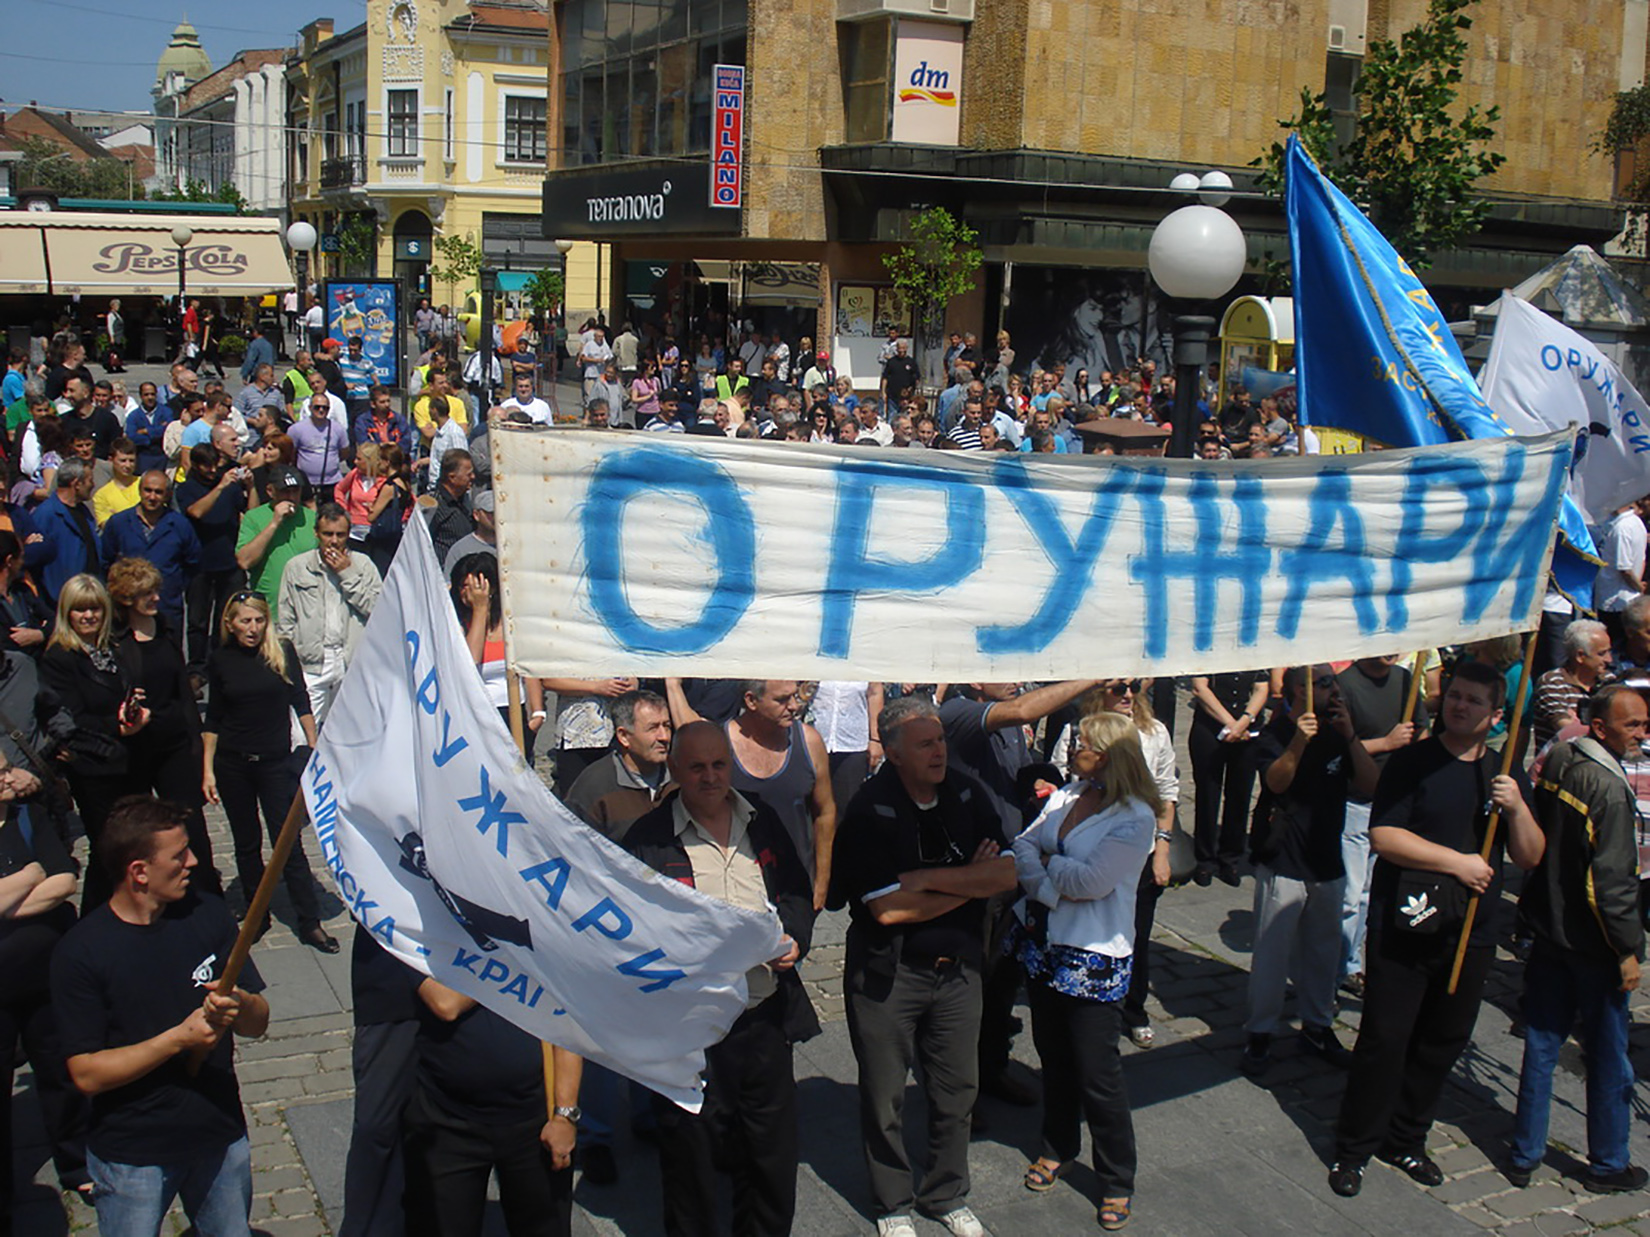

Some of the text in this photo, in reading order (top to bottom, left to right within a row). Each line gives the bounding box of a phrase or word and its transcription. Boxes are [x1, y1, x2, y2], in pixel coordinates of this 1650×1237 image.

[910, 61, 949, 89] dm
[717, 92, 740, 203] MILANO
[578, 440, 1573, 659] ОРУЖАРИ
